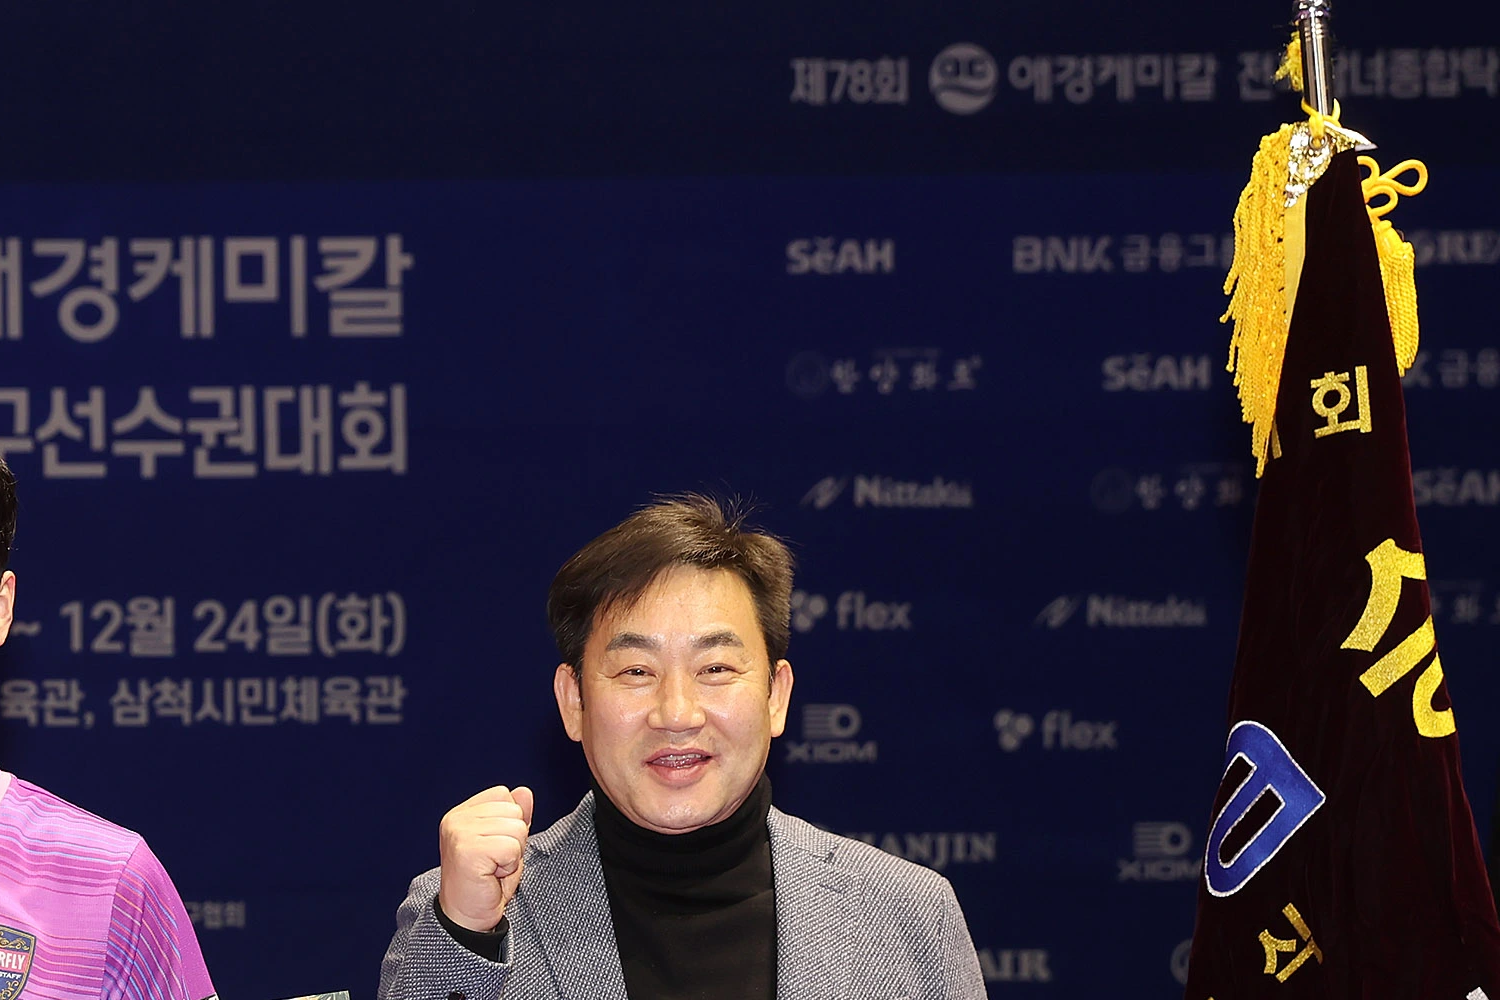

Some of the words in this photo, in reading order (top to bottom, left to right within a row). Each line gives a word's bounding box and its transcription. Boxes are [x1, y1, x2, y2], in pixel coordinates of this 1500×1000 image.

[1311, 365, 1372, 439] 회
[60, 597, 175, 657] 12월
[194, 593, 405, 657] 24일(화)
[836, 590, 912, 631] flex
[111, 676, 405, 727] 삼척시민체육관
[1042, 709, 1119, 751] flex
